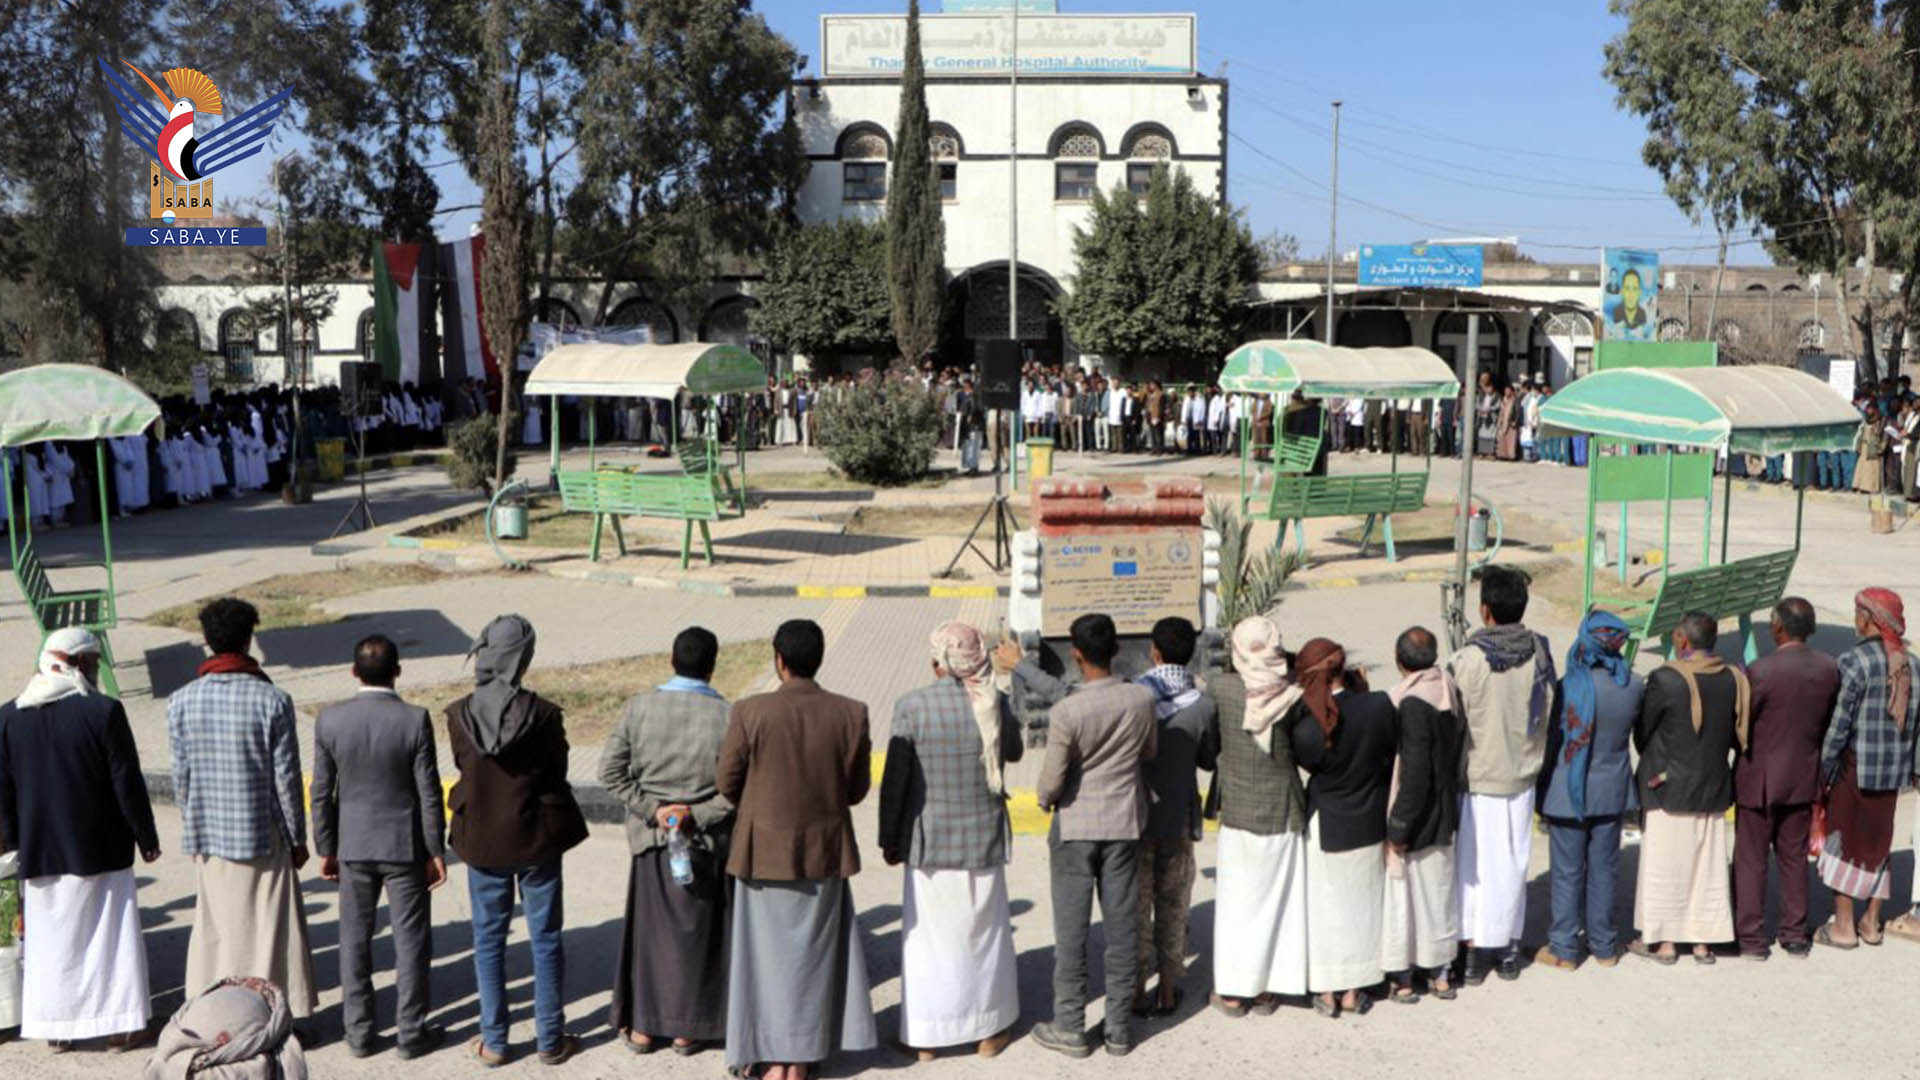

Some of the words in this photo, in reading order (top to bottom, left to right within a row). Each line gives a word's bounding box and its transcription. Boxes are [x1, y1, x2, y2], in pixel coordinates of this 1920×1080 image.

[935, 56, 997, 69] General
[1001, 56, 1069, 70] Hospital
[1074, 56, 1148, 70] Authority
